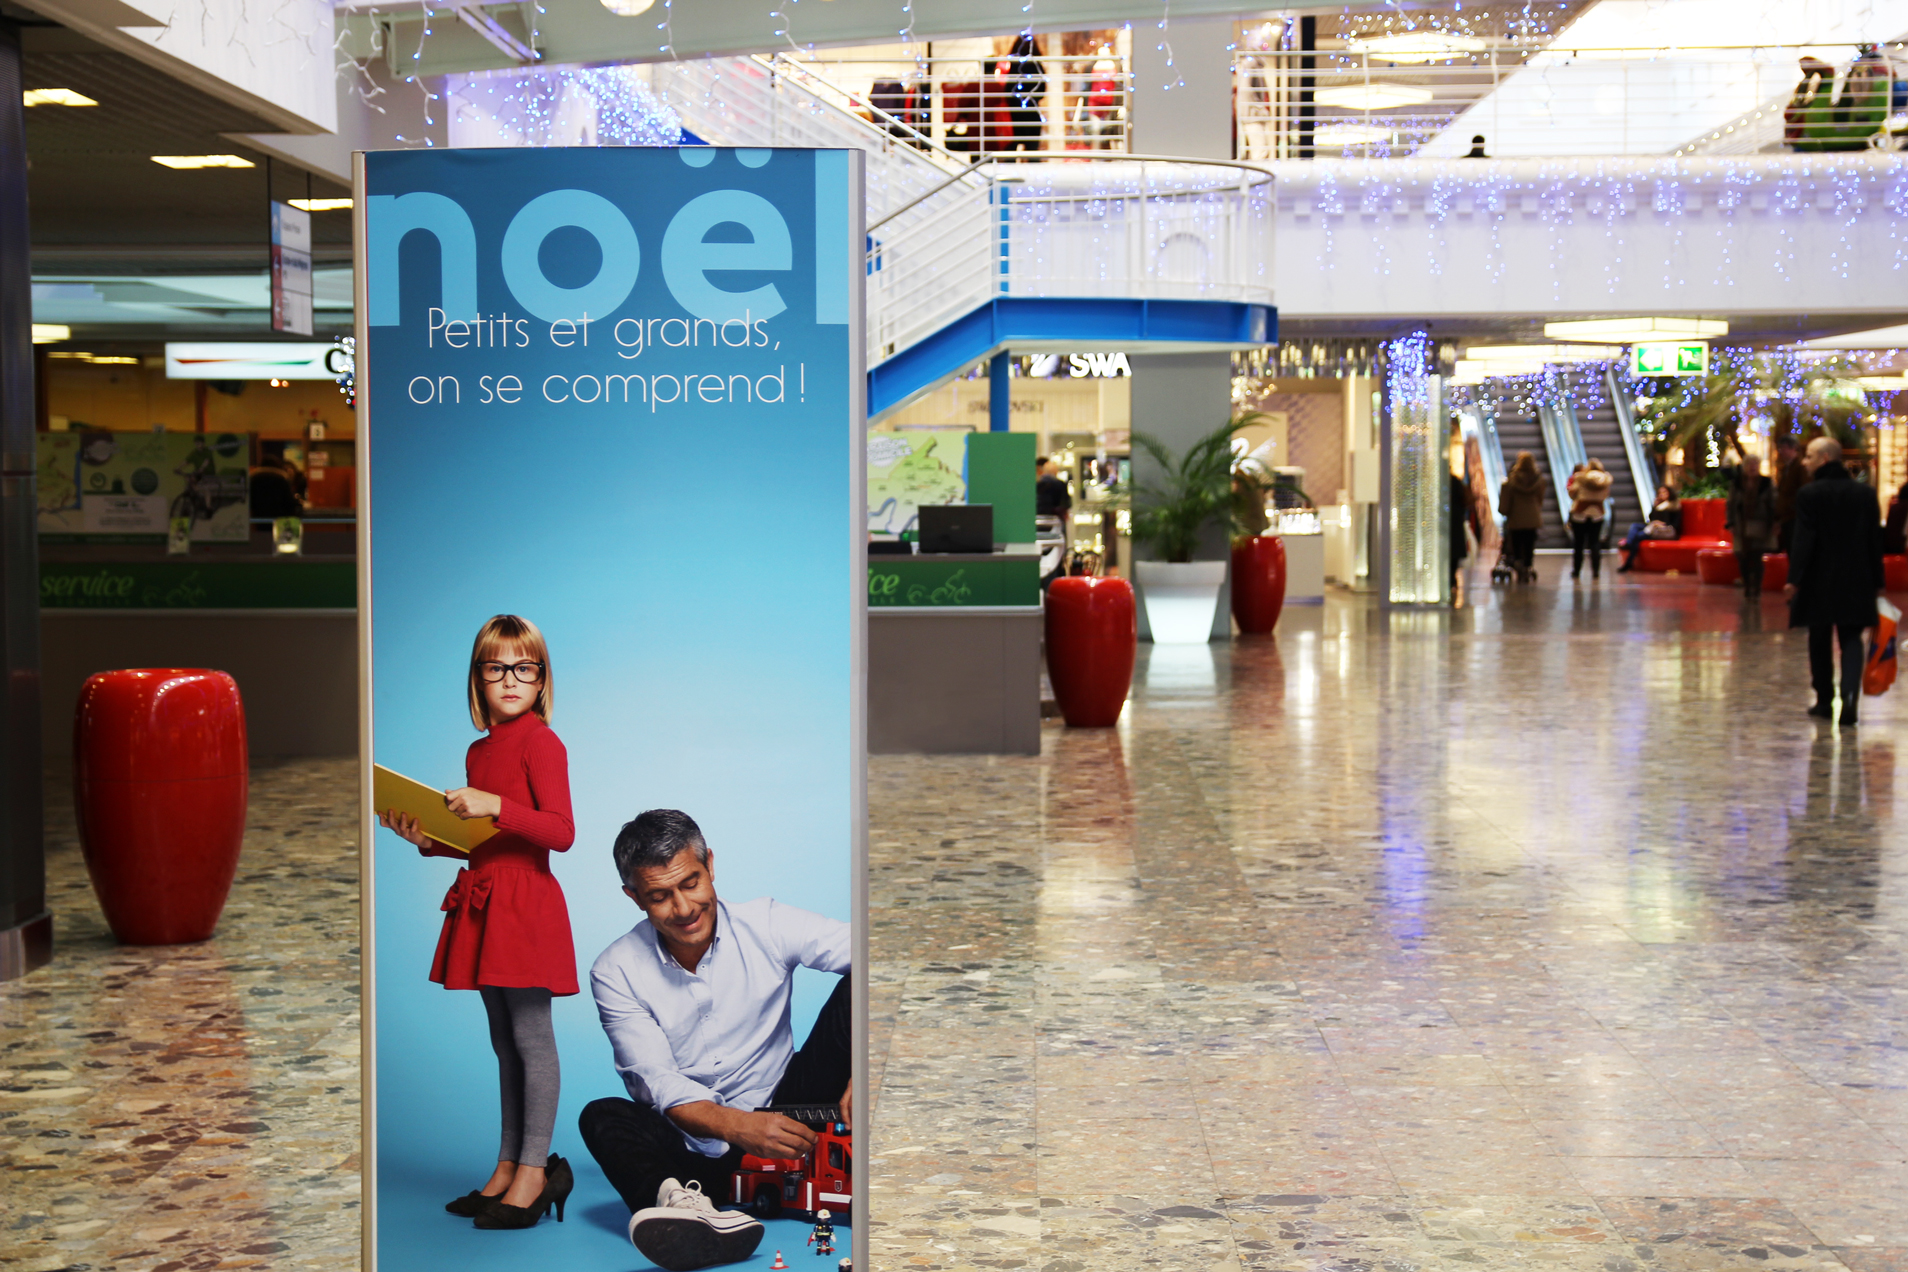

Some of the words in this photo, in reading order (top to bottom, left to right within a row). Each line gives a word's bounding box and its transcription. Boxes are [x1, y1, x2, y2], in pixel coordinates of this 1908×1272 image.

[427, 307, 530, 349] Petits
[550, 311, 595, 348] et
[614, 308, 781, 360] grands,
[1069, 352, 1132, 378] SWA
[408, 374, 460, 404] on
[479, 374, 523, 404] se
[40, 569, 135, 598] service
